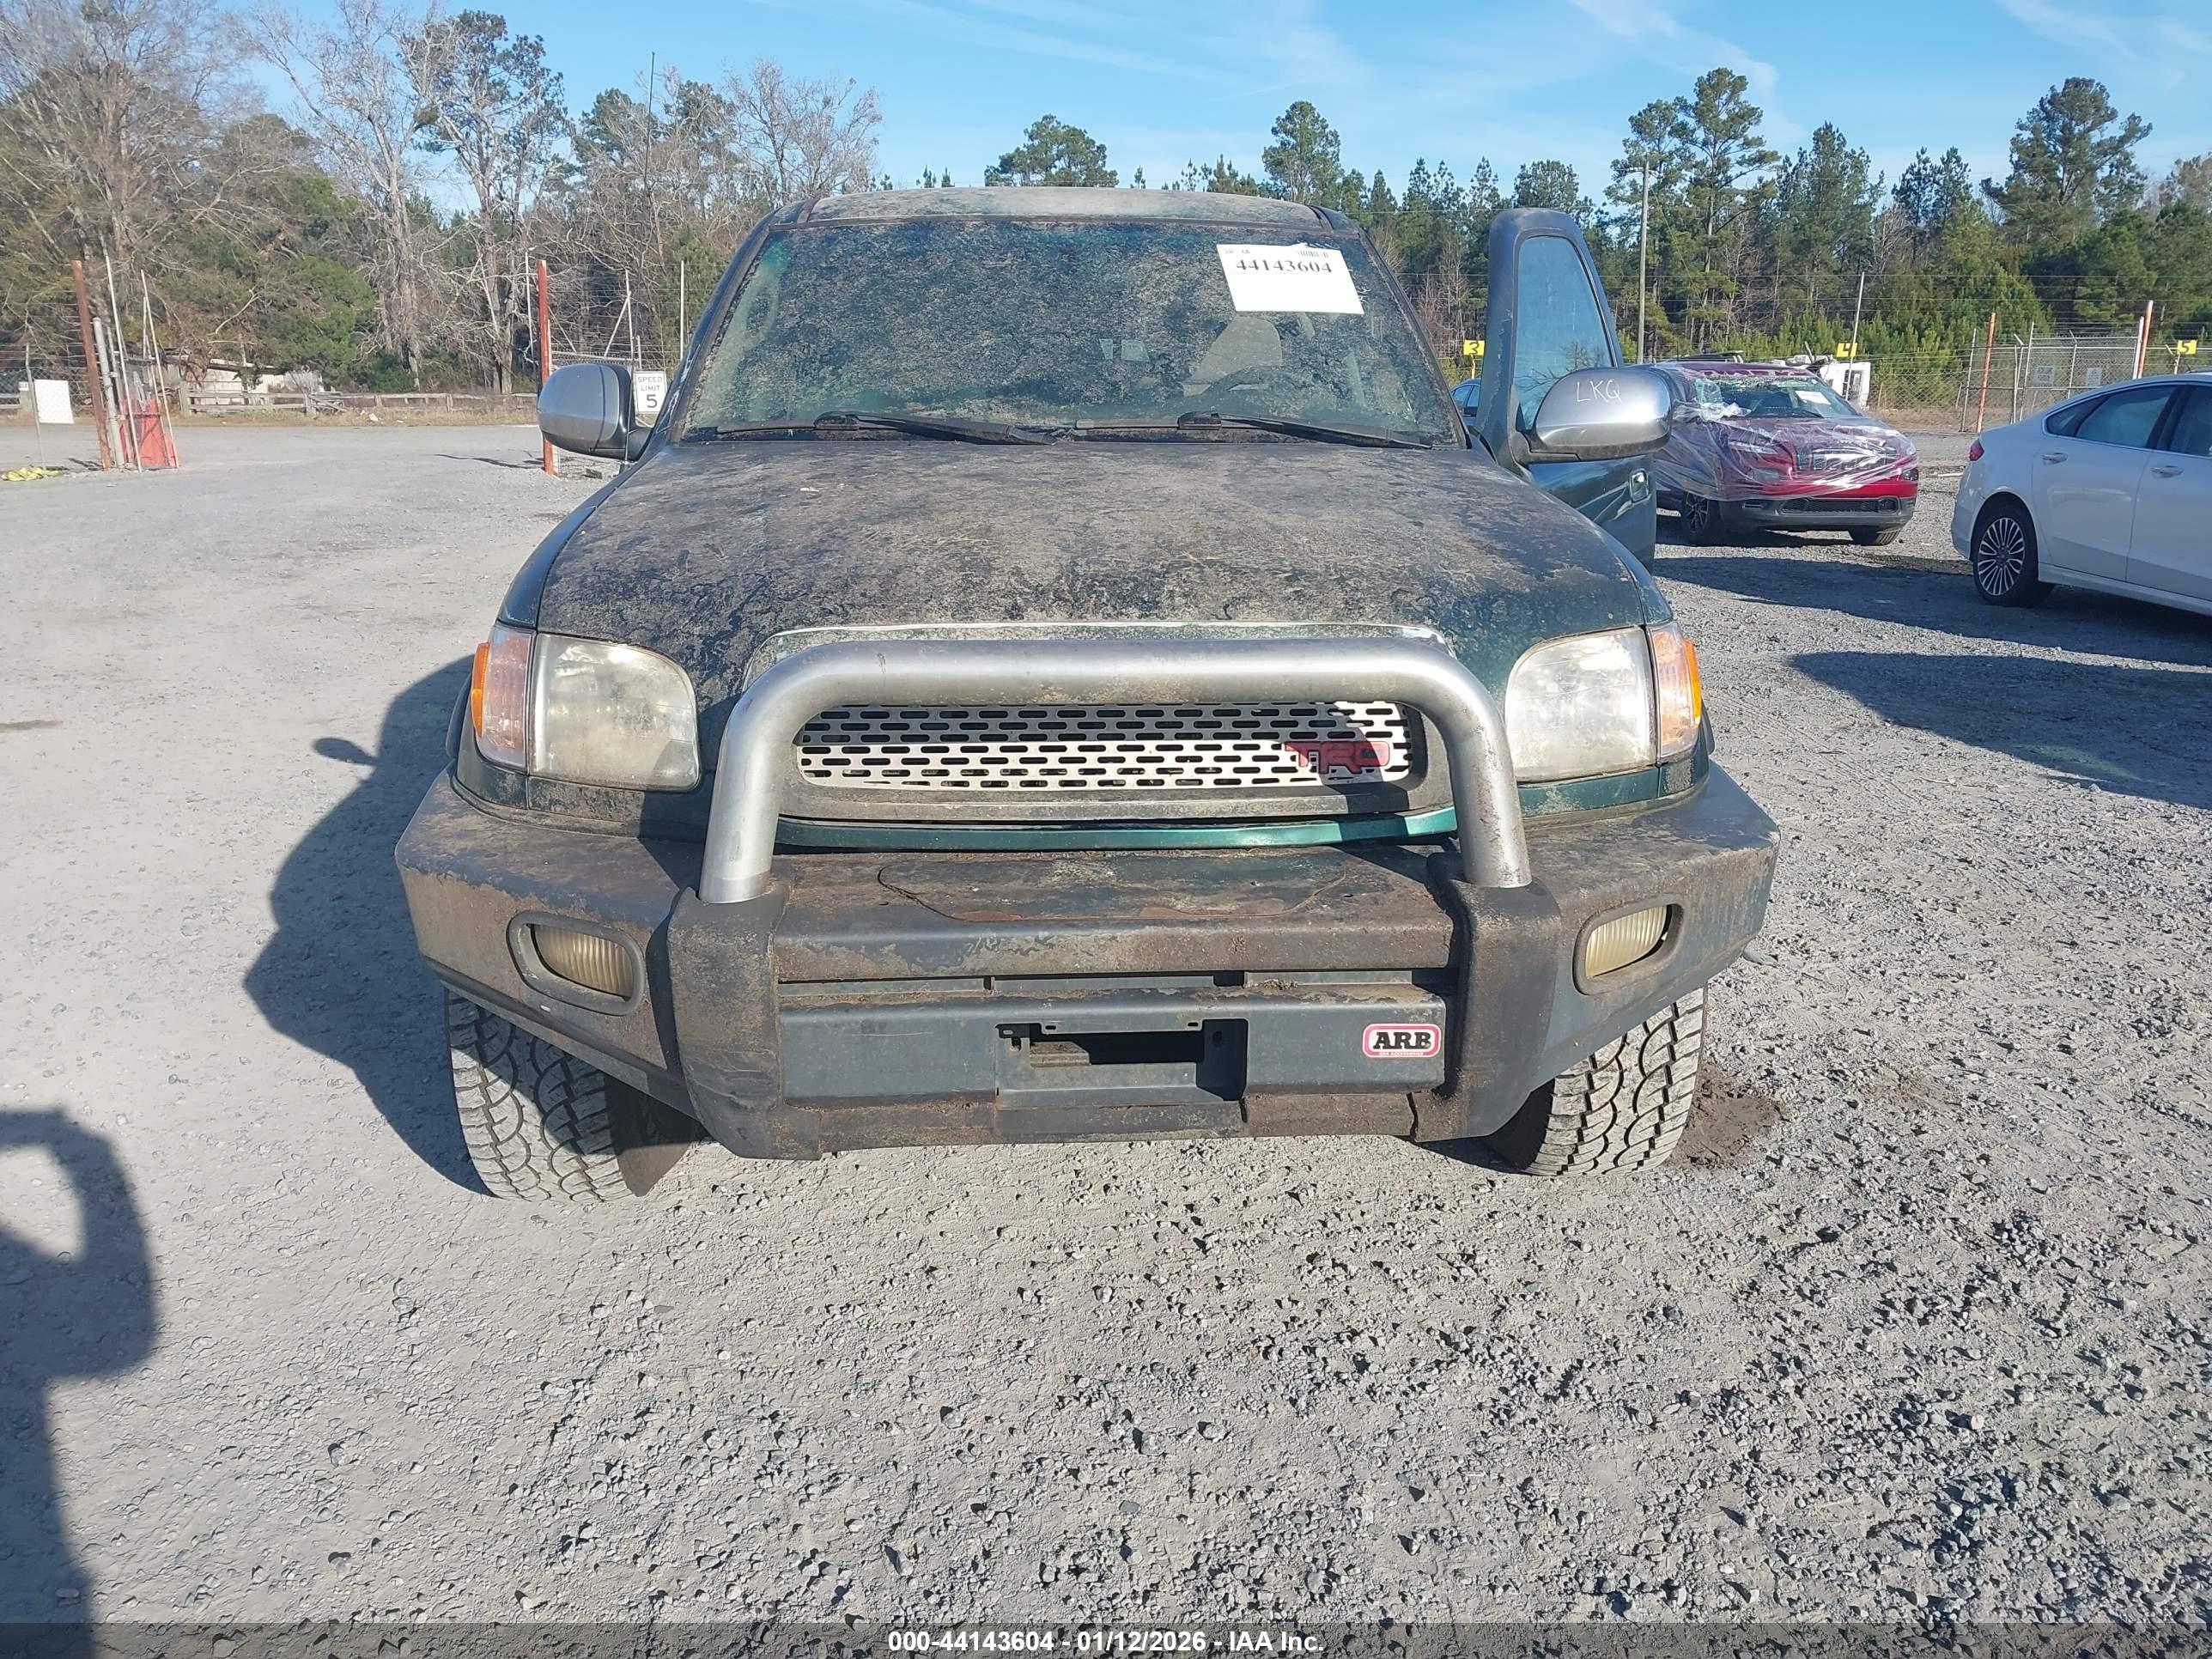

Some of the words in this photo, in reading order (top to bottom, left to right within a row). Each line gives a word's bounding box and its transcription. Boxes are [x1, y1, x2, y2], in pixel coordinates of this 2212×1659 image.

[1236, 259, 1333, 273] 44143604
[1468, 341, 1480, 355] 3
[2181, 340, 2190, 354] 5
[1577, 378, 1622, 403] LKQ
[646, 394, 658, 408] 5
[1284, 740, 1390, 775] TRD
[1373, 1031, 1431, 1049] ARB
